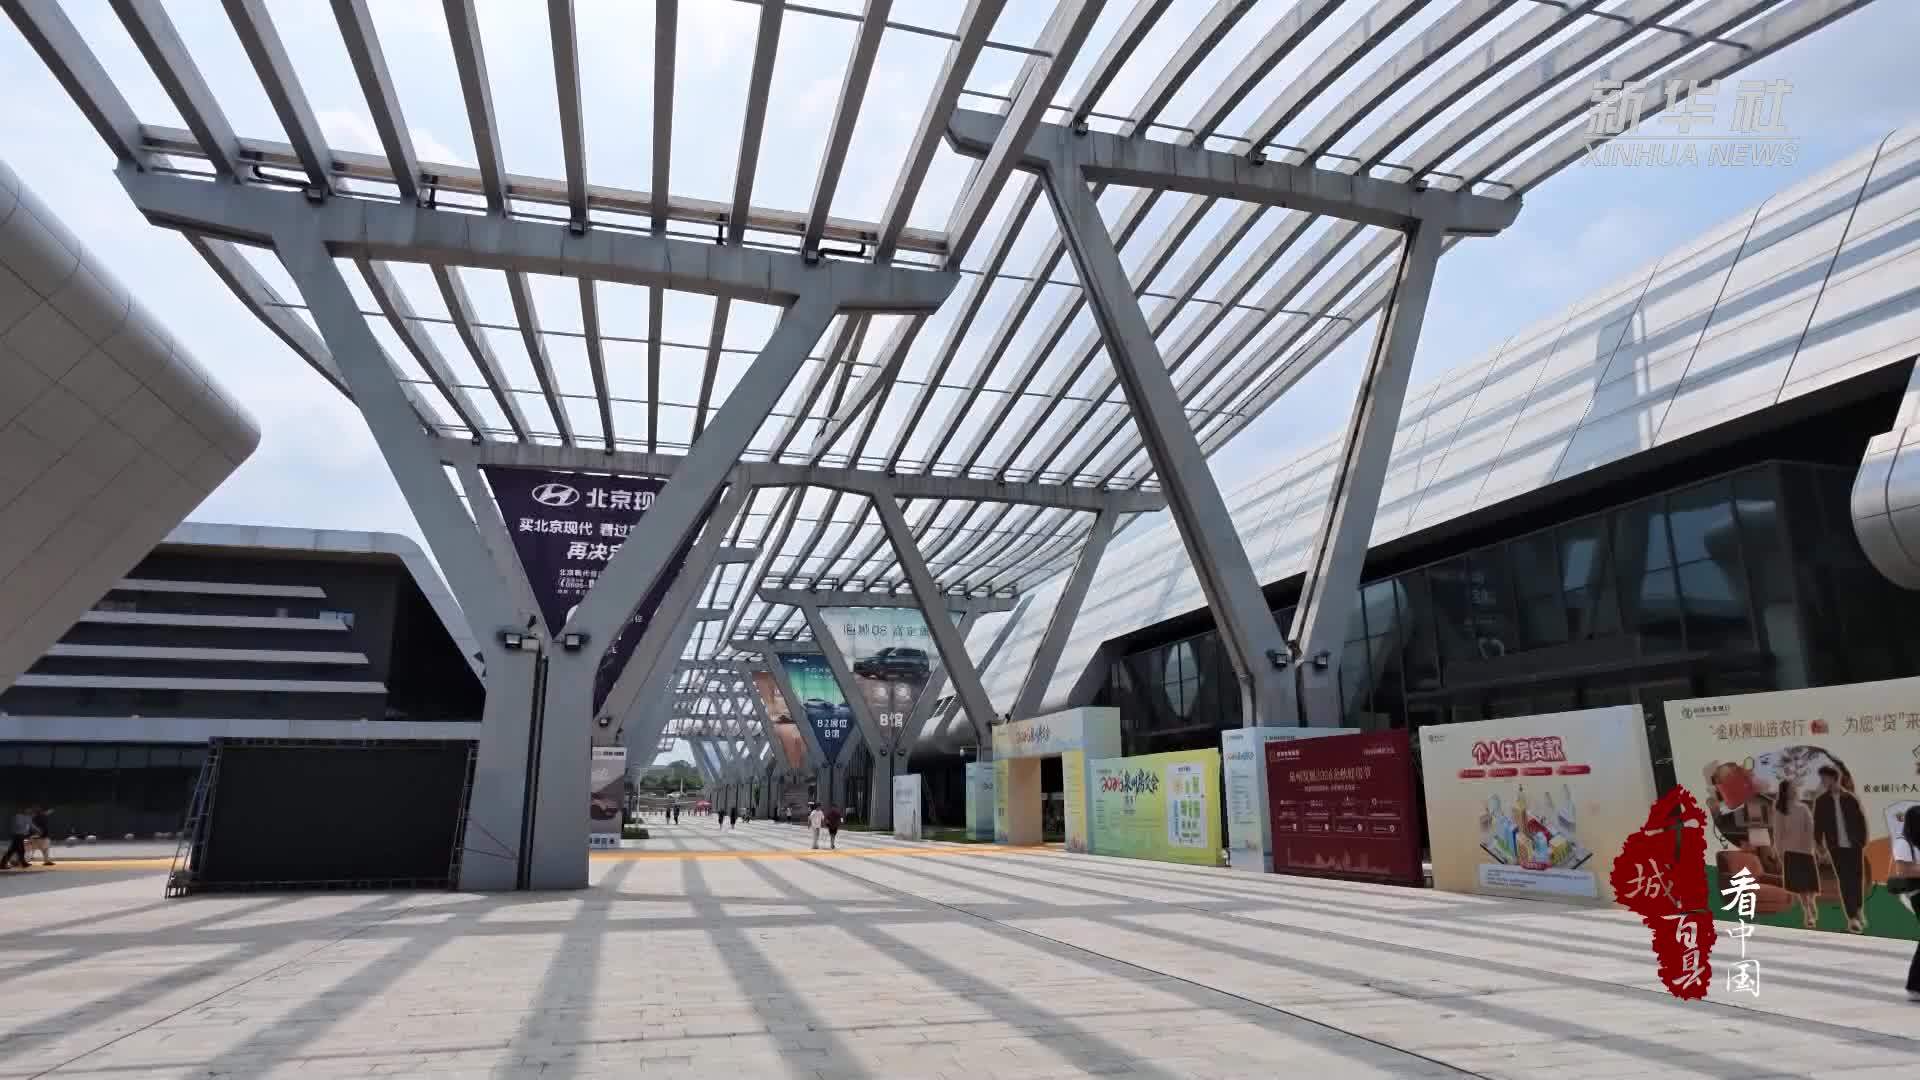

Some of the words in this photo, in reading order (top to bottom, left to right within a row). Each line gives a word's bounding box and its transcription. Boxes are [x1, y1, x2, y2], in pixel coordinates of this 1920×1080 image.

[519, 518, 593, 535] 买北京现代
[600, 523, 638, 537] 看过
[879, 712, 904, 728] B馆
[1472, 737, 1567, 765] 个人住房贷款
